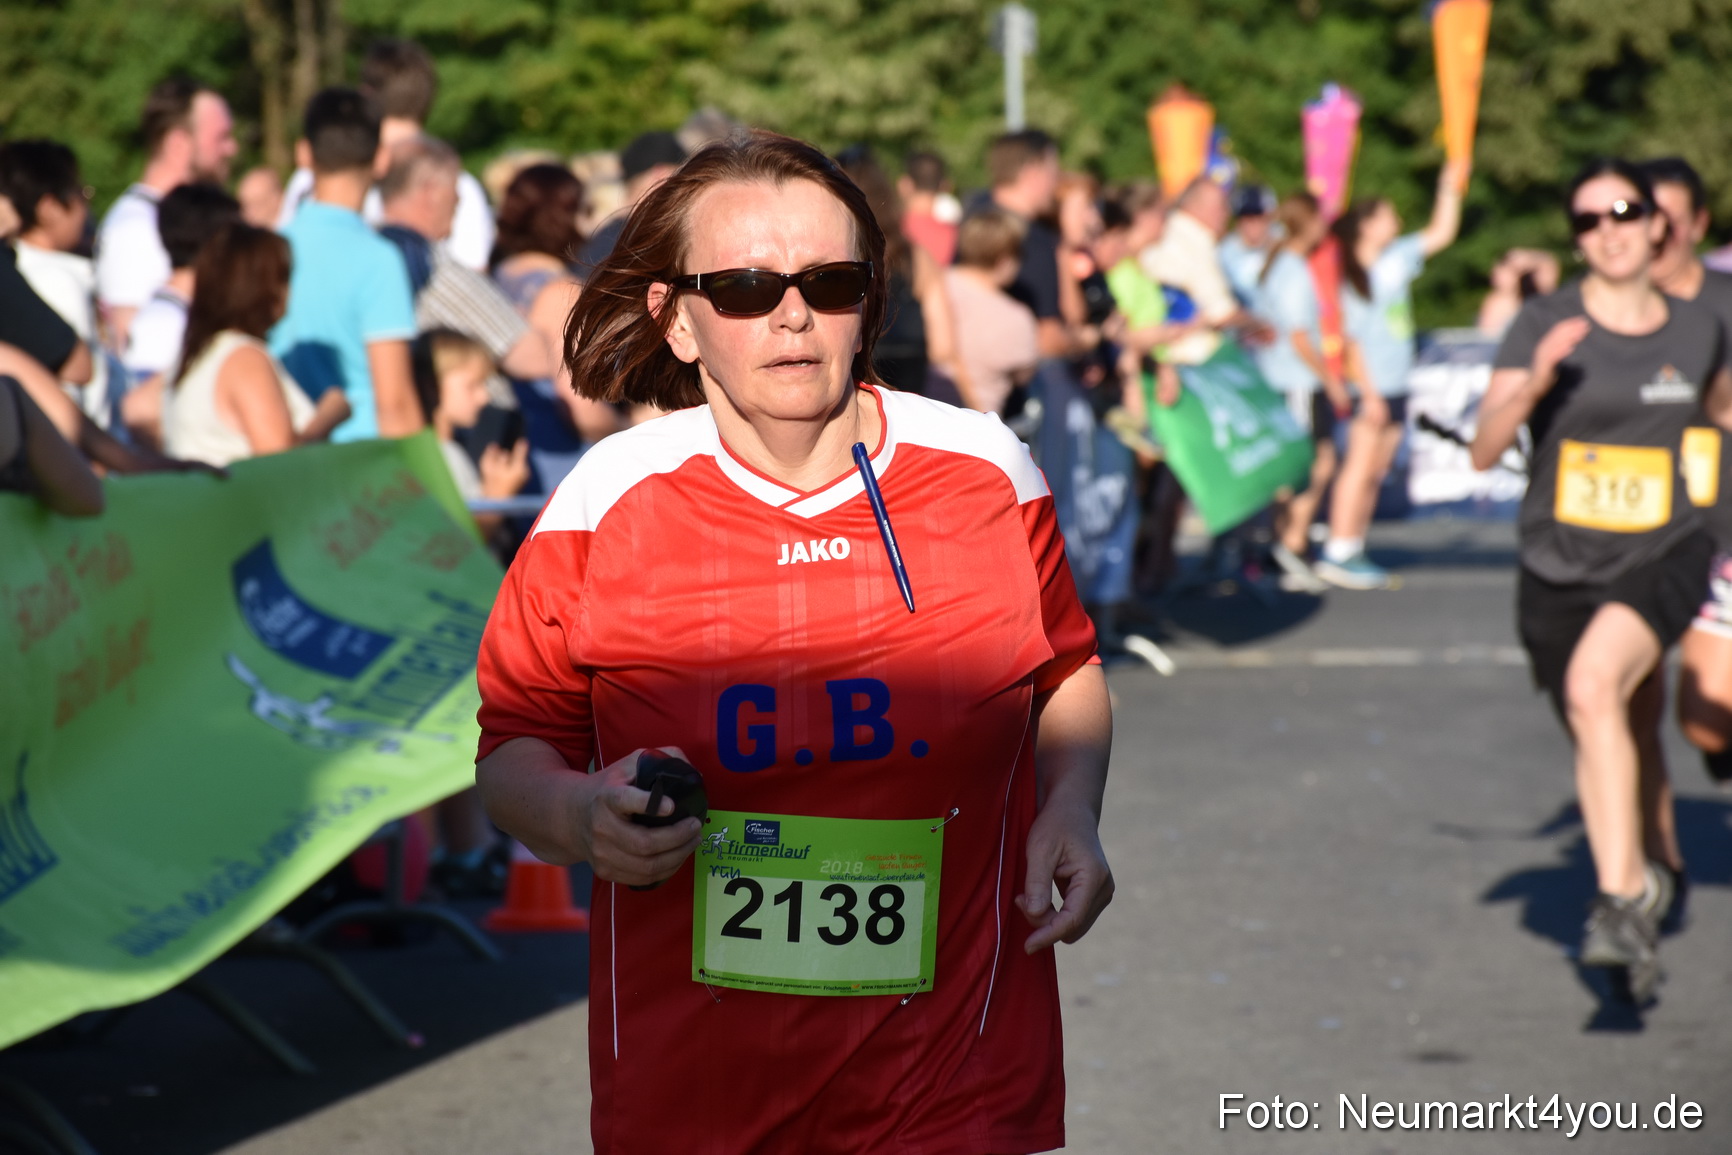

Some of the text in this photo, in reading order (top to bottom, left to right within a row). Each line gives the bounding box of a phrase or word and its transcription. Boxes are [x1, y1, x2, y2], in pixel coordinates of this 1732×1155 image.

[777, 537, 850, 565] JAKO
[751, 825, 775, 834] Fischer
[728, 840, 812, 859] firmenlauf
[727, 855, 763, 863] neumarkt
[820, 860, 864, 874] 2018
[720, 877, 906, 946] 2138
